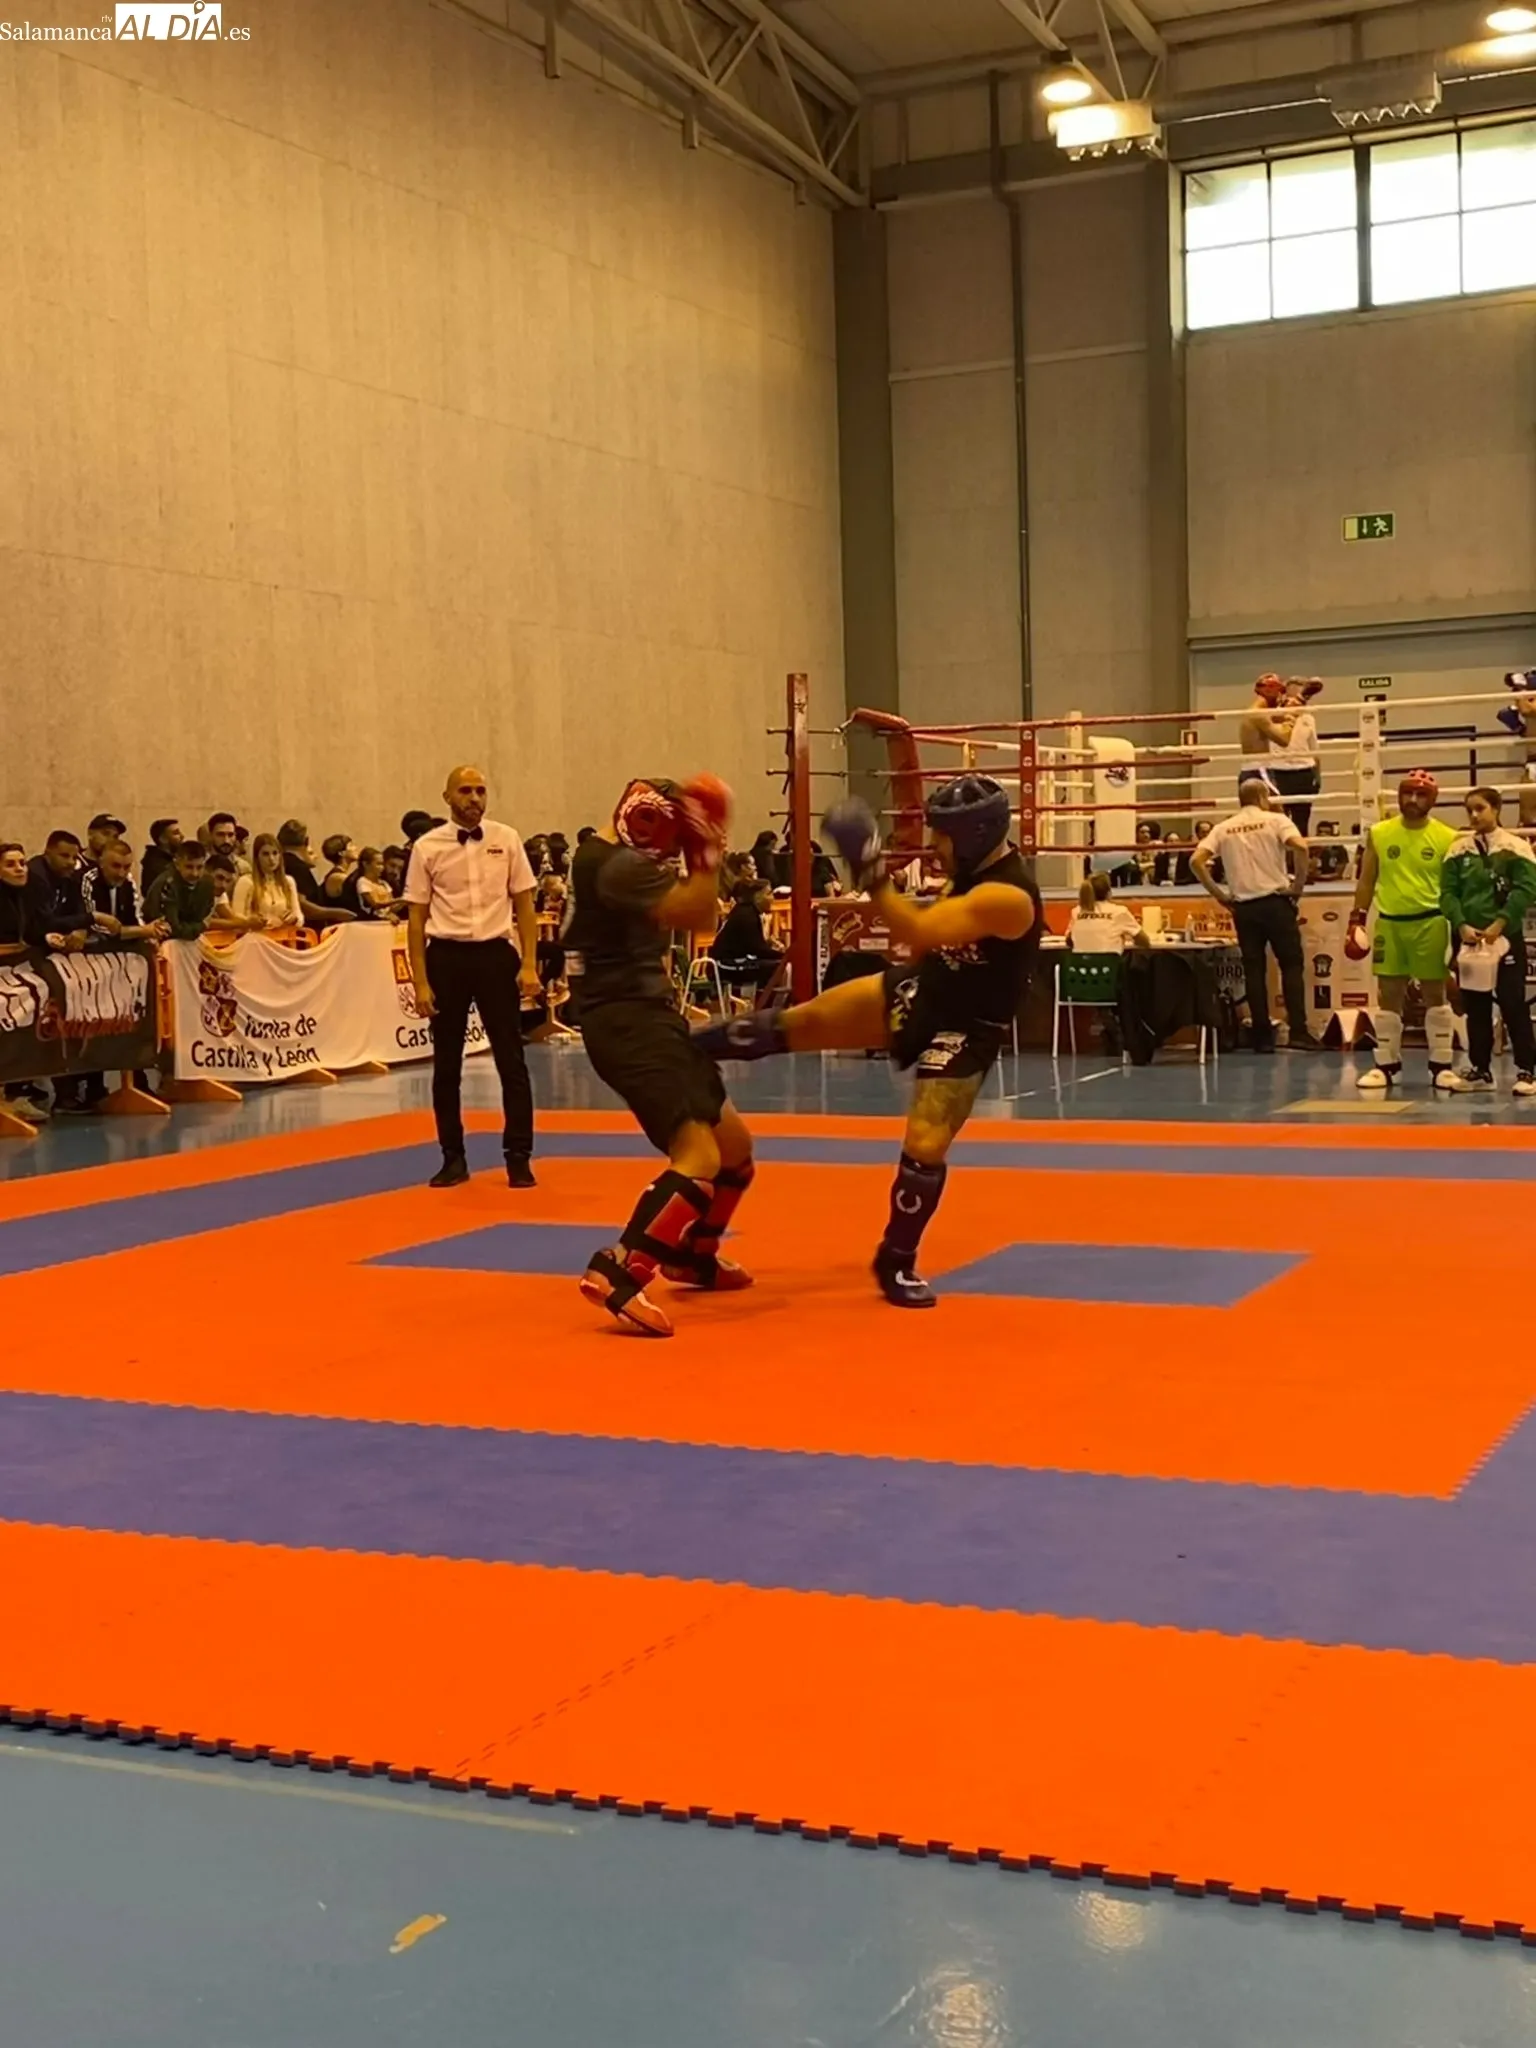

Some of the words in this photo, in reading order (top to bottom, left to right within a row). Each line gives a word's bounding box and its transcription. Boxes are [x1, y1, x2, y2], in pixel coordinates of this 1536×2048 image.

[295, 1013, 317, 1036] de
[191, 1040, 259, 1069] Castilla
[263, 1052, 274, 1076] y
[276, 1043, 321, 1068] León
